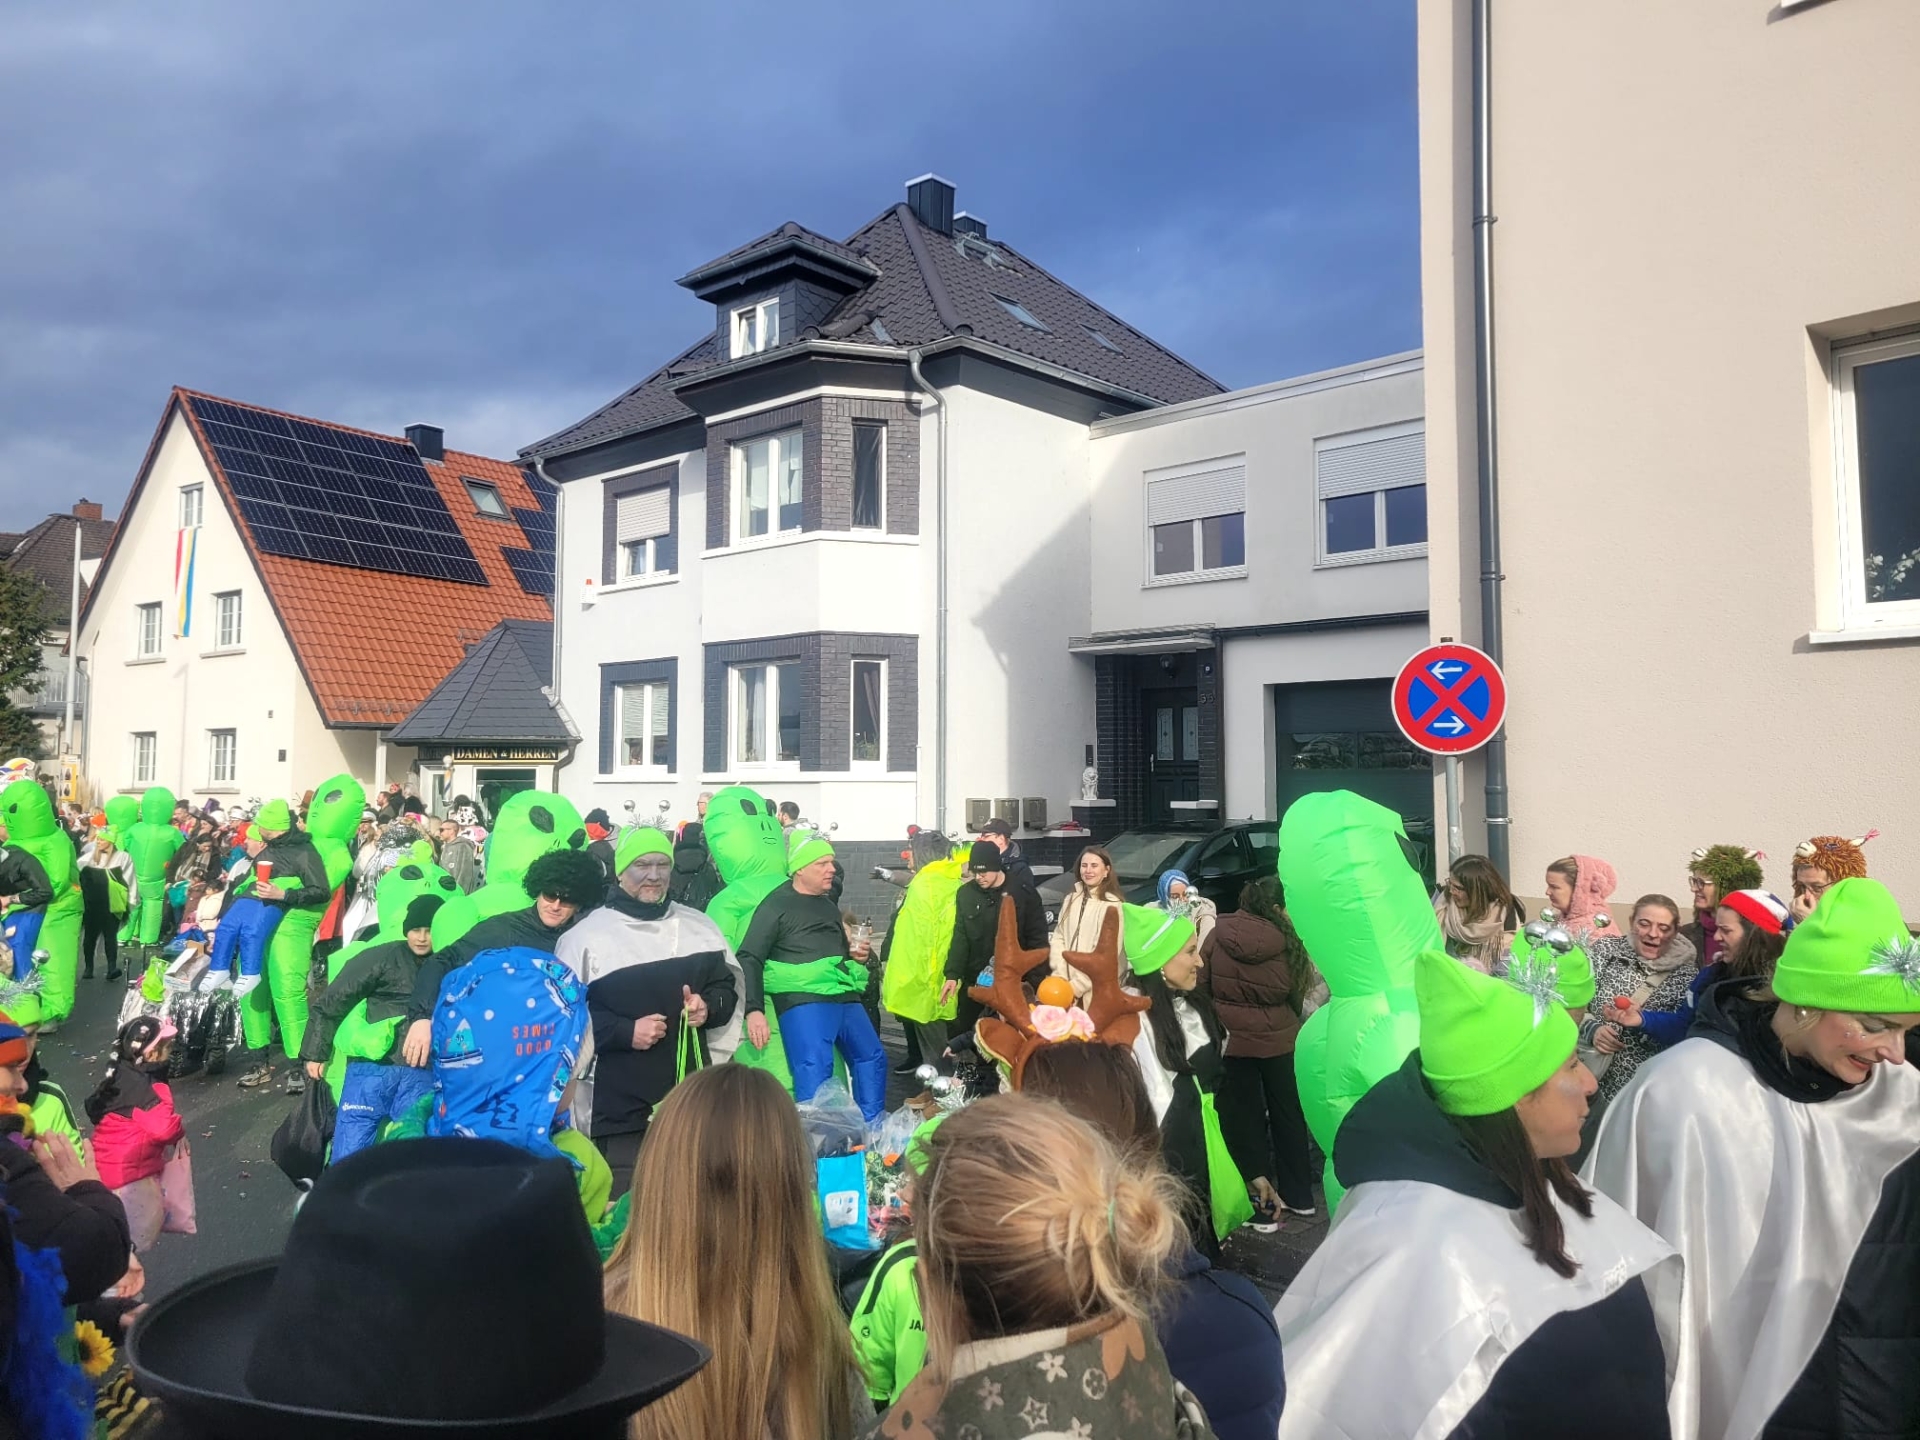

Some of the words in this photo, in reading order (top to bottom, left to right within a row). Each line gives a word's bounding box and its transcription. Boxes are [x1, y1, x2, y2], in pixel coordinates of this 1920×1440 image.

[456, 747, 498, 759] DAMEN
[500, 750, 508, 758] &
[509, 747, 556, 759] HERREN
[512, 1022, 555, 1039] TIMES
